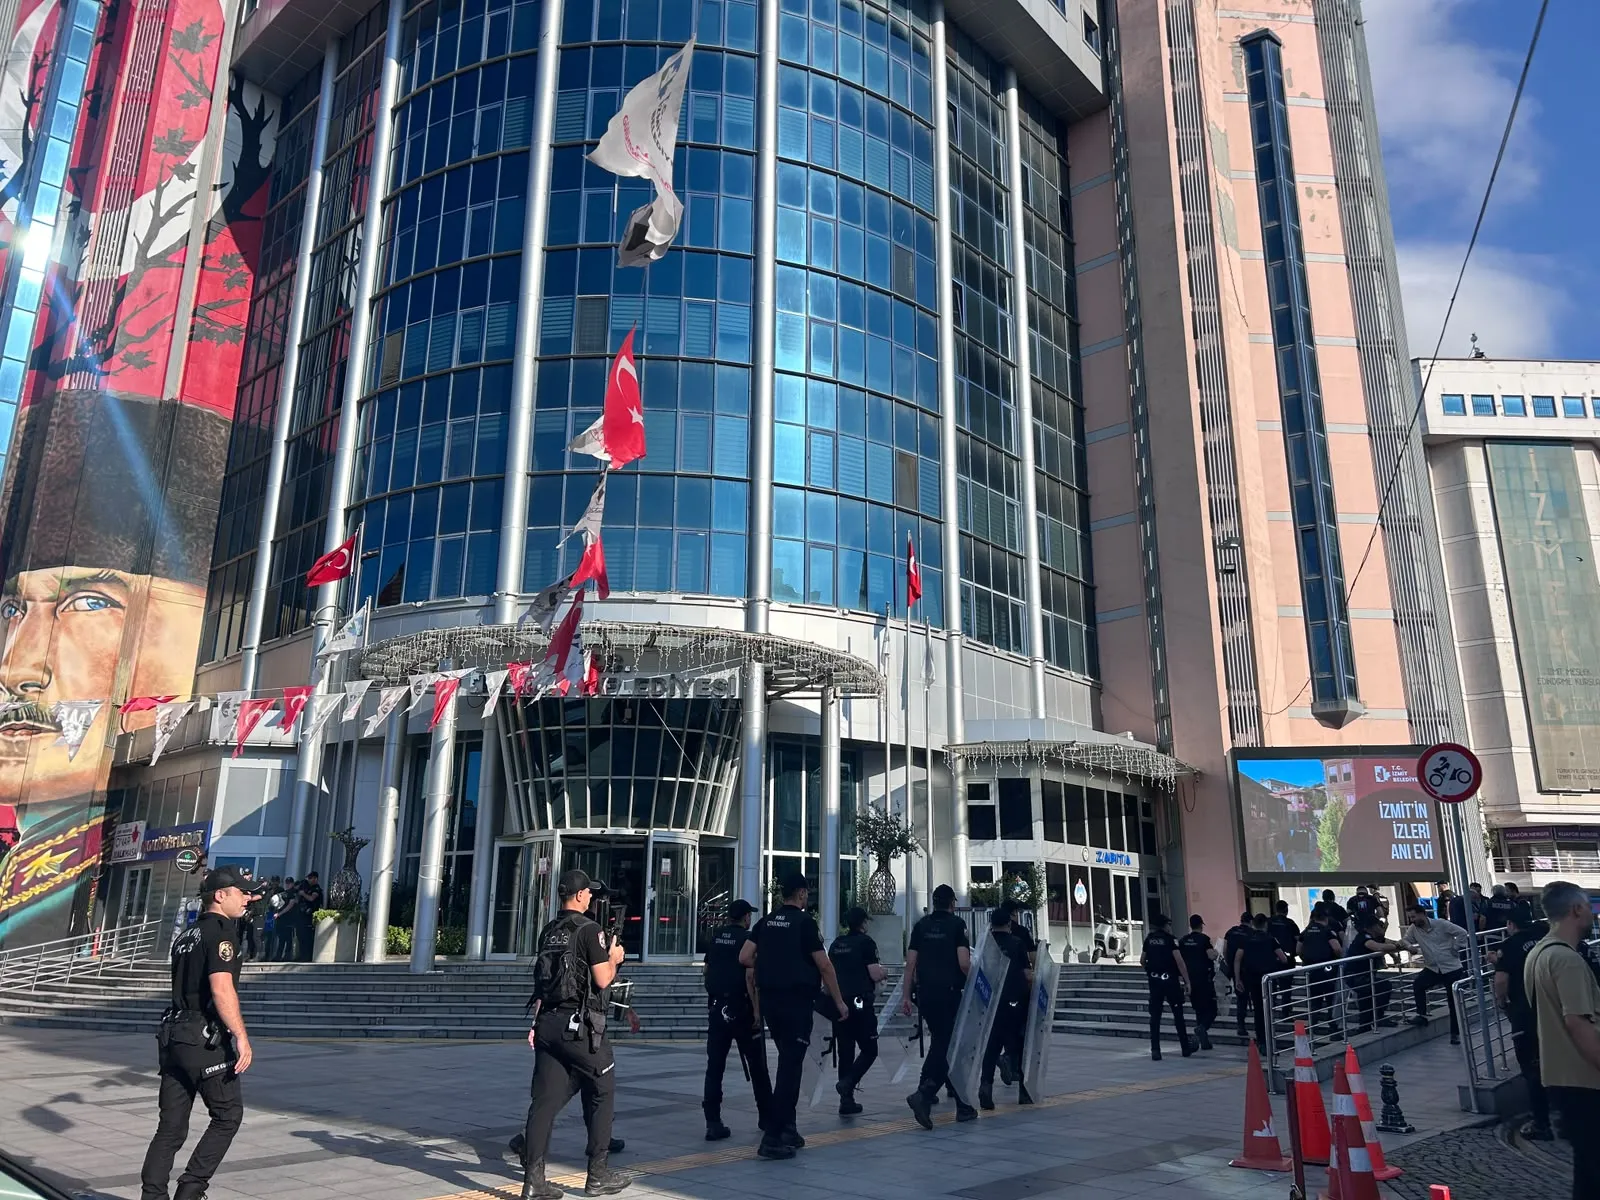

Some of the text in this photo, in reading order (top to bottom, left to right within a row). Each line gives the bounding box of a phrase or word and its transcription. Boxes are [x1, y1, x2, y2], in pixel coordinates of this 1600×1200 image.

[603, 674, 738, 697] ELEDİYESİ
[1378, 800, 1428, 819] İZMİT'İN
[1392, 821, 1431, 839] İZLERİ
[1391, 841, 1434, 860] ANI EVİ
